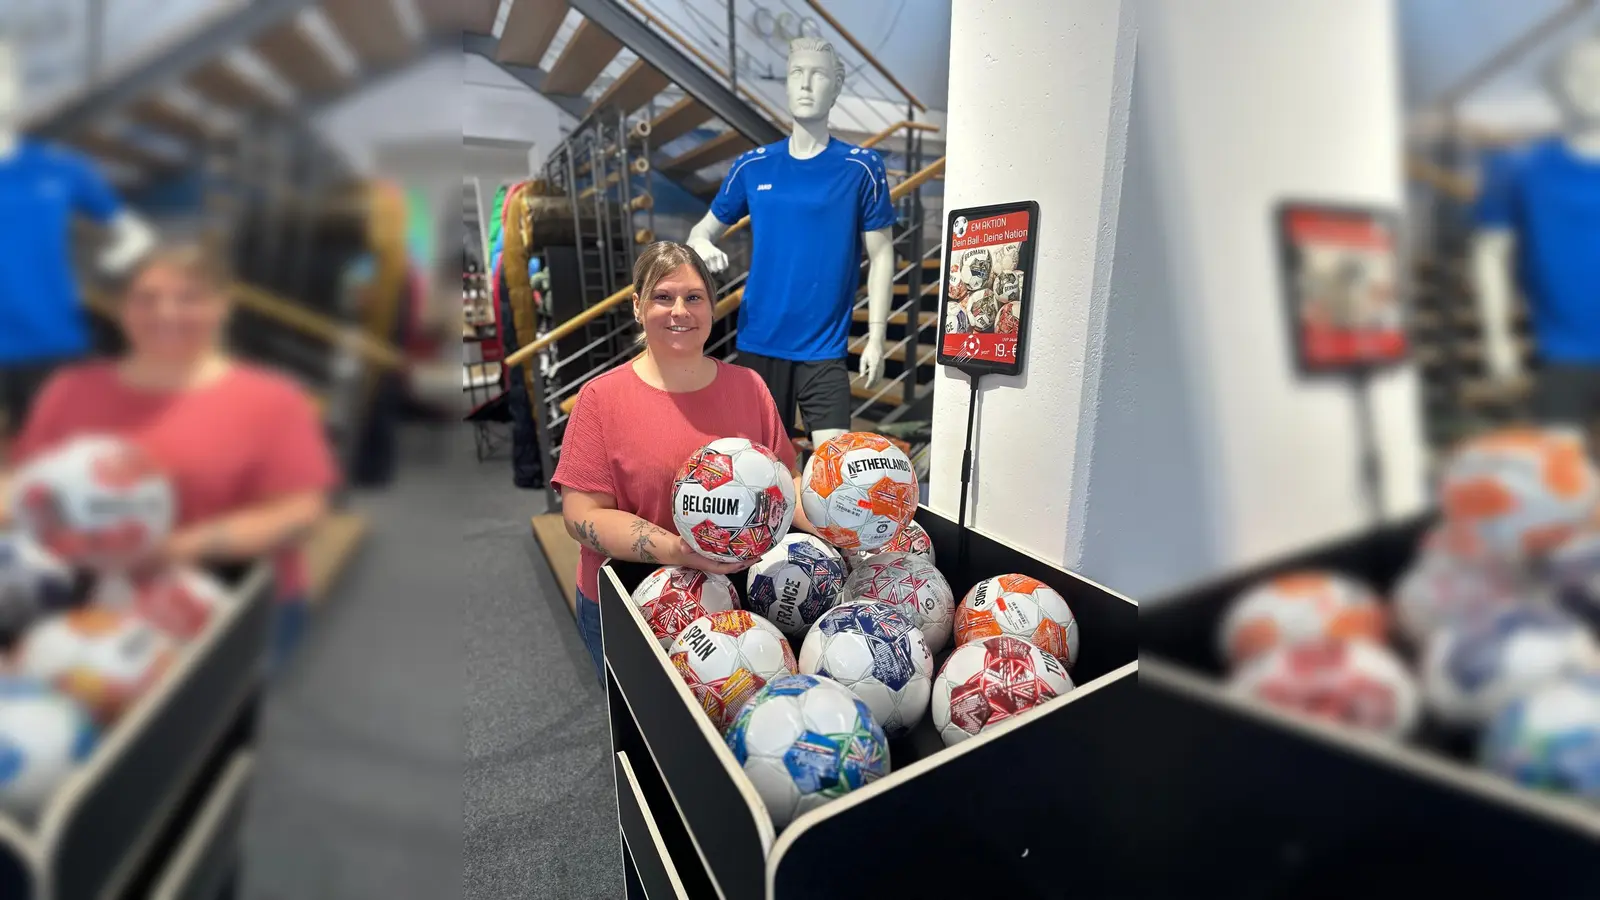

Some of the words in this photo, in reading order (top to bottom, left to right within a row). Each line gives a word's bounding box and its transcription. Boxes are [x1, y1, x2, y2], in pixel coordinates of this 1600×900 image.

[971, 223, 981, 232] EM
[982, 217, 1007, 231] AKTION
[952, 239, 967, 248] Dein
[967, 235, 980, 246] Ball
[983, 233, 1003, 243] Deine
[1004, 229, 1028, 239] Nation
[847, 457, 911, 475] NETHERLANDS
[682, 493, 740, 516] BELGIUM
[776, 577, 801, 627] FRANCE
[683, 625, 717, 662] SPAIN
